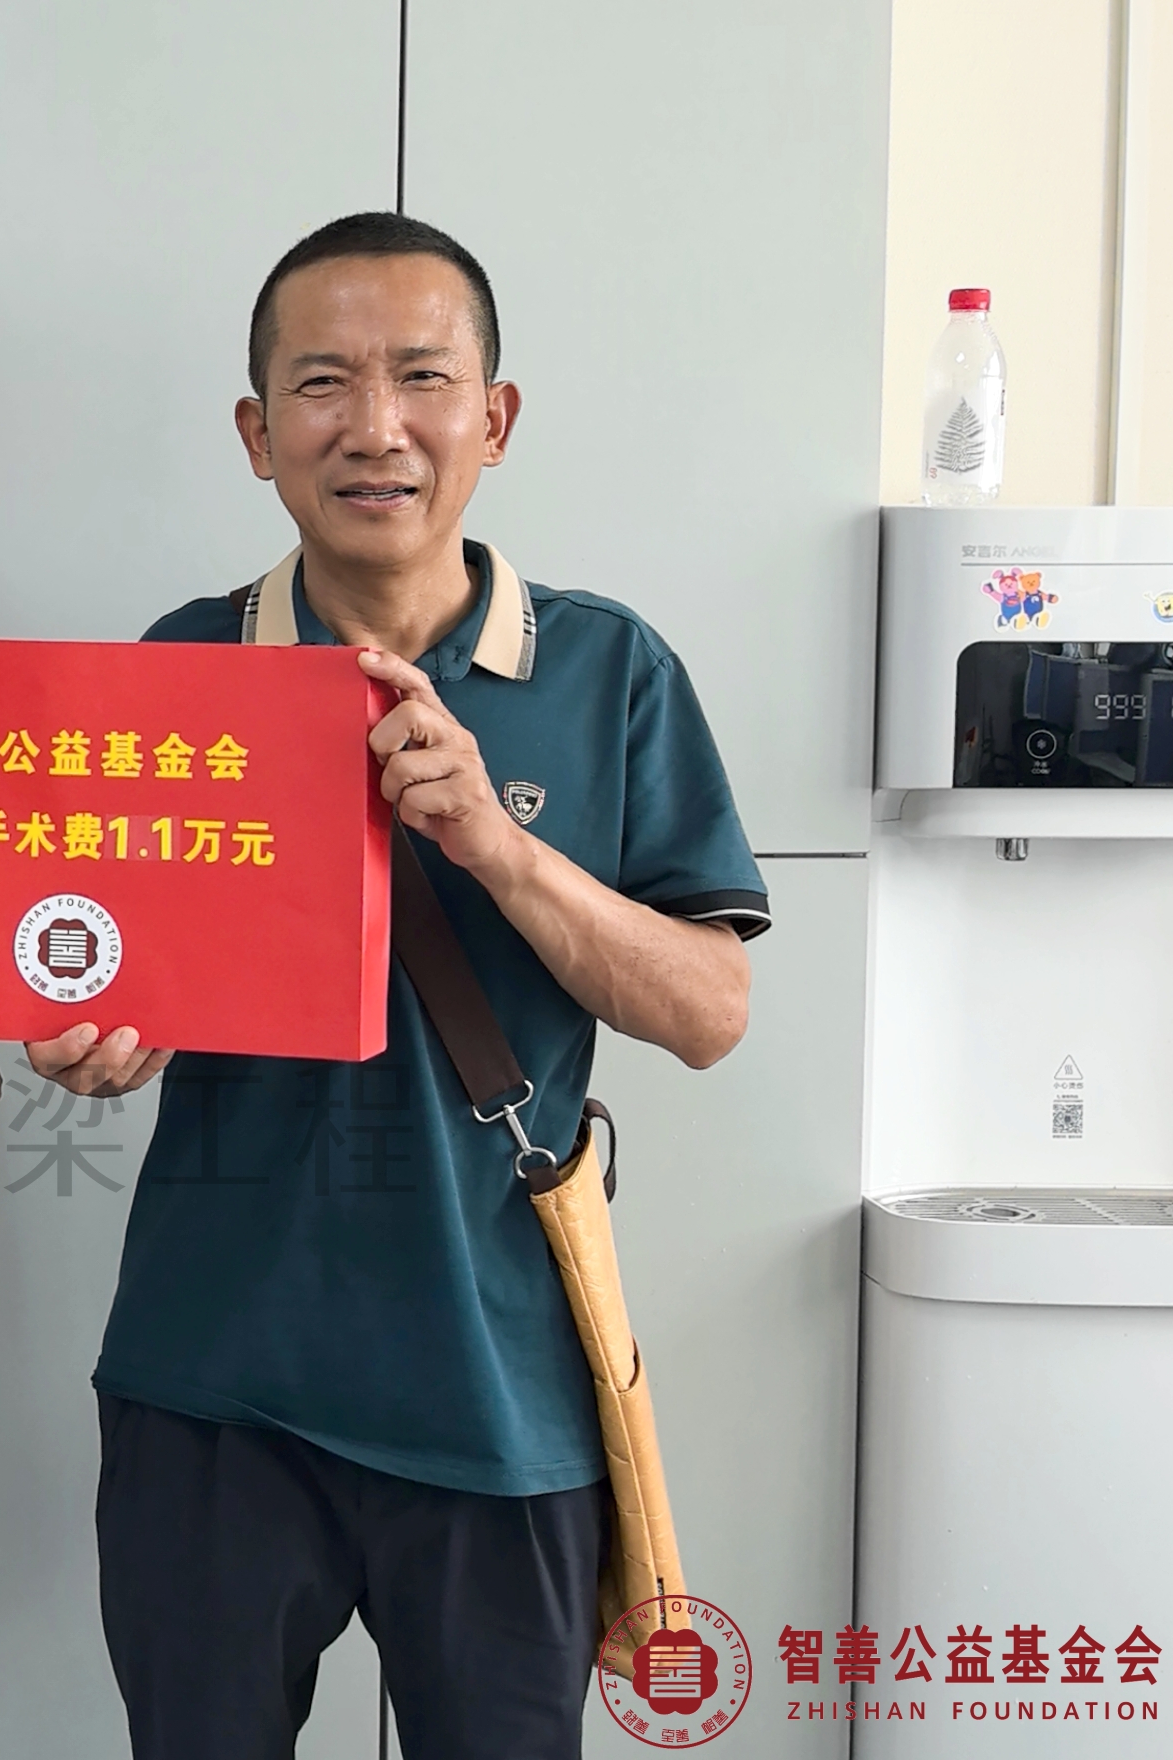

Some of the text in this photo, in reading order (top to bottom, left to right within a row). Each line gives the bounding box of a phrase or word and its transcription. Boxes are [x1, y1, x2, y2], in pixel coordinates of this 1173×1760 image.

[1094, 694, 1147, 720] 999
[17, 898, 119, 964] ZHISHAN FOUNDATION
